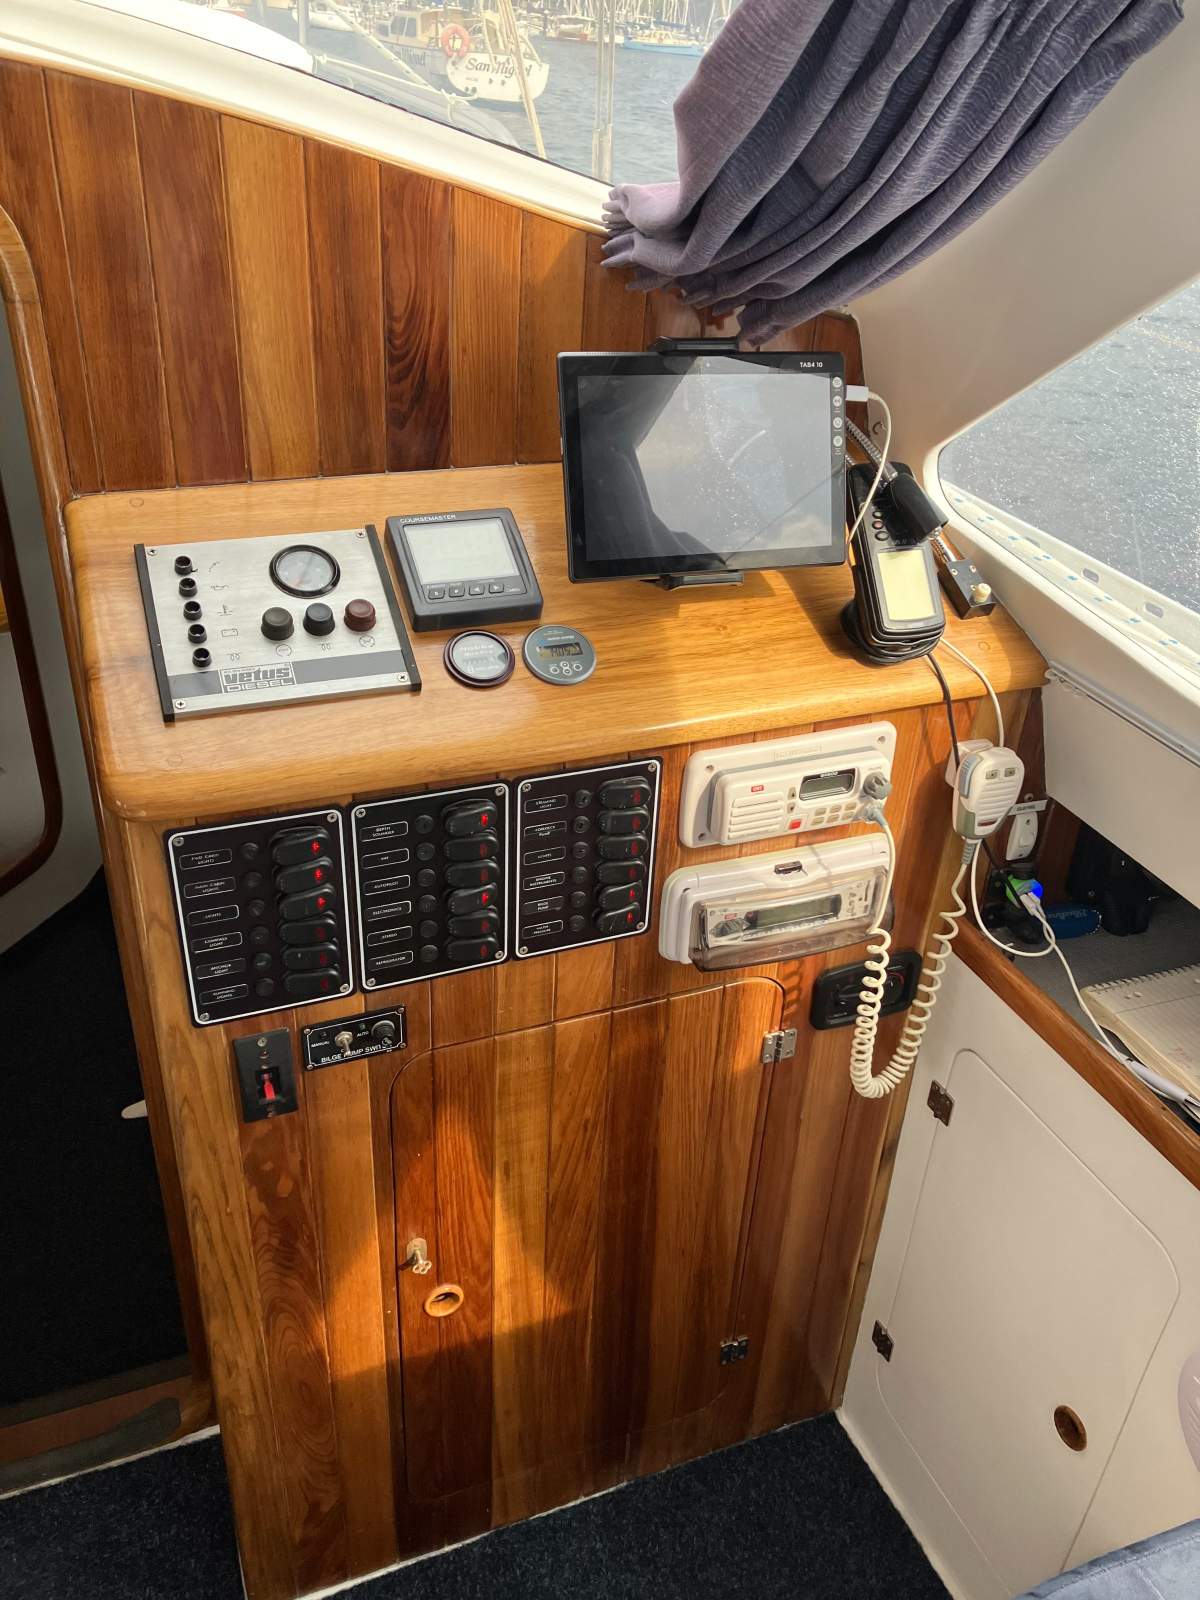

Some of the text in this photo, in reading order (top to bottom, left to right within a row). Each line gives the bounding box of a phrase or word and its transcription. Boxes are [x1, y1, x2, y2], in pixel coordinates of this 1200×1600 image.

[465, 57, 490, 72] San
[399, 514, 456, 524] COURSEMASTER
[226, 679, 293, 692] DIESEL
[320, 1053, 342, 1063] BILGE
